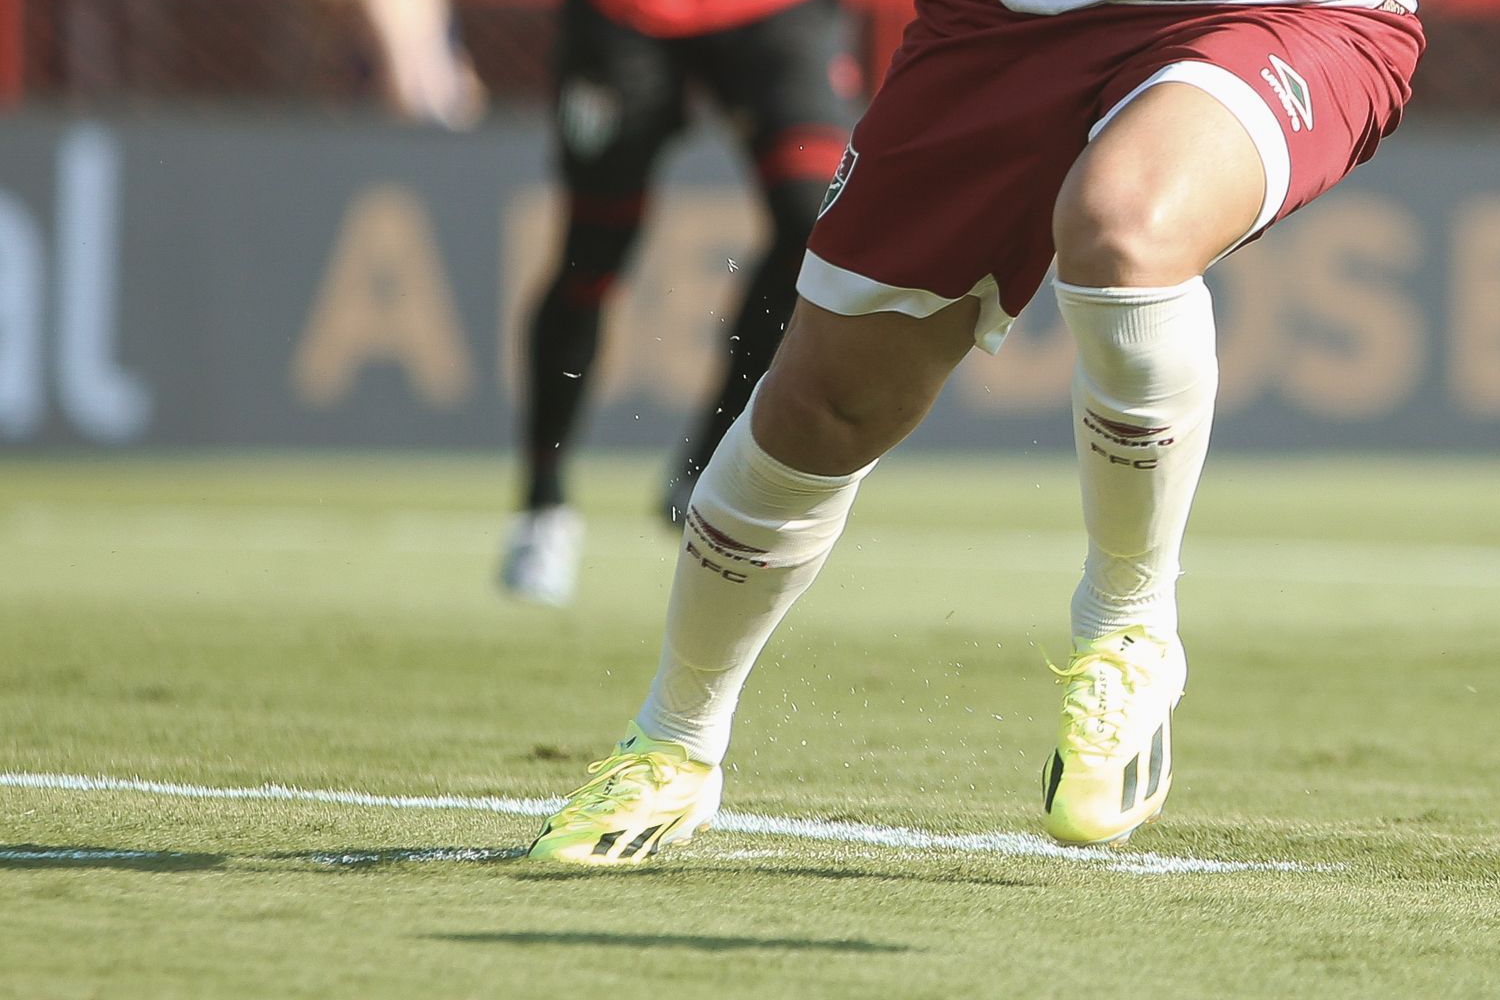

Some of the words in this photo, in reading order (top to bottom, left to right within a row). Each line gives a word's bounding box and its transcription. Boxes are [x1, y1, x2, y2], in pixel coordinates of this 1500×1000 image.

[1082, 415, 1175, 448] umbro
[1090, 441, 1159, 471] FFC
[686, 540, 748, 584] FFC
